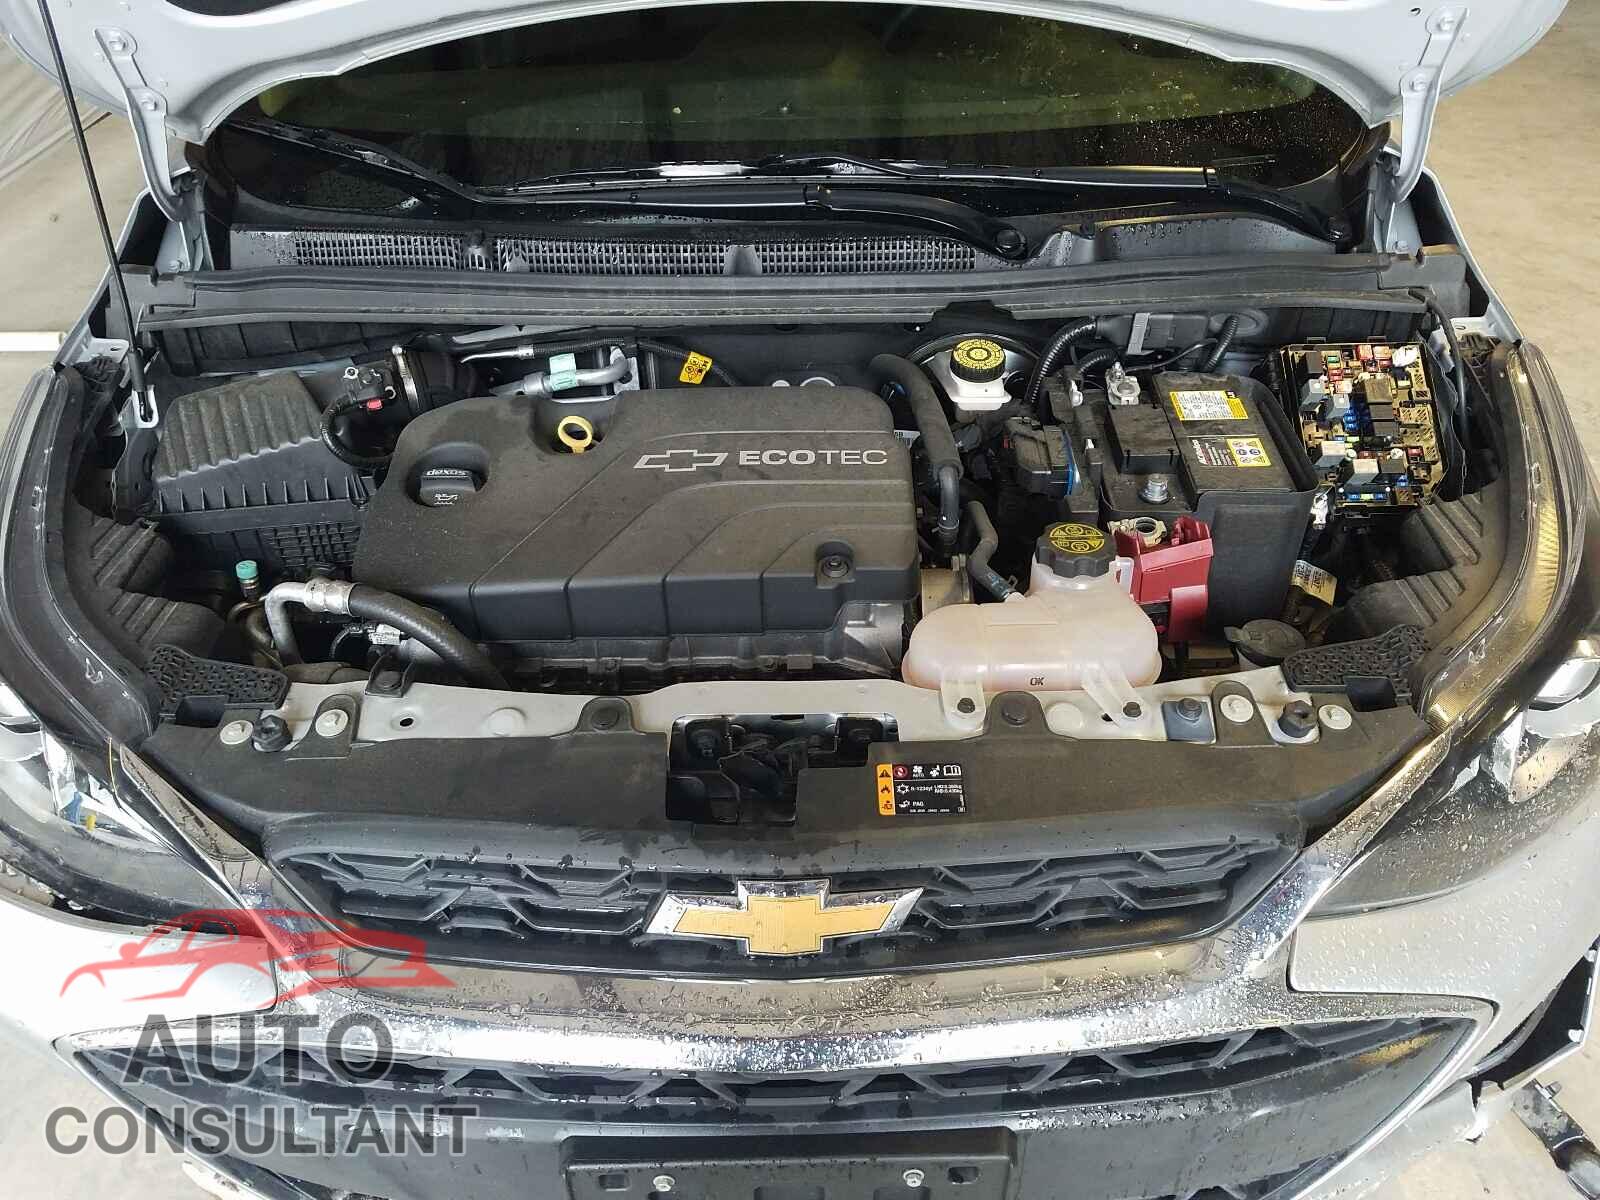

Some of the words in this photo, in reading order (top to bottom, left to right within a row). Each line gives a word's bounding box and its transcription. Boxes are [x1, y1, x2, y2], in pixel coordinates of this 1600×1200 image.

[738, 449, 889, 466] ECOTEC
[426, 468, 472, 476] dexos
[1030, 677, 1045, 686] OK
